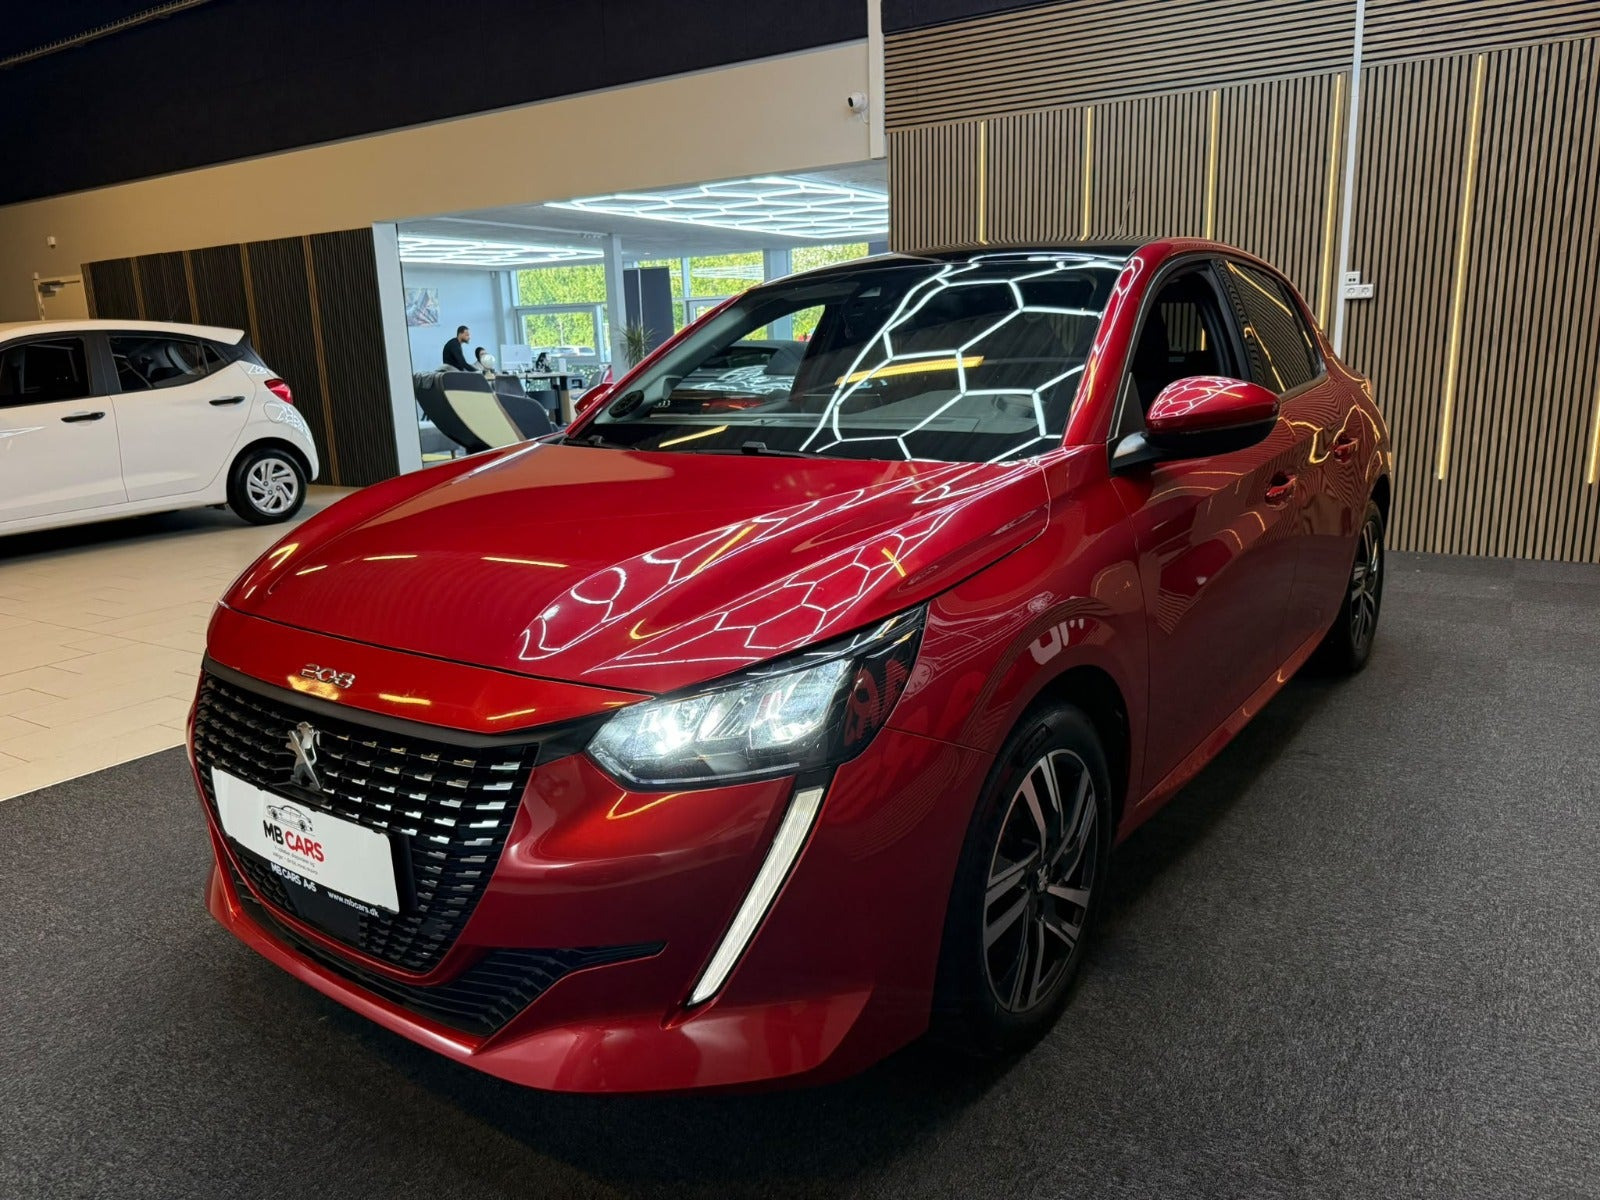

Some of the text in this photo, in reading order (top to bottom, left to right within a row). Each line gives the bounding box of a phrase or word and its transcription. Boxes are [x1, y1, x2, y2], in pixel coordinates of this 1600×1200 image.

[301, 664, 356, 689] 208
[263, 819, 284, 845] MB
[285, 830, 325, 863] CARS
[327, 890, 380, 918] www.mbcars.dk
